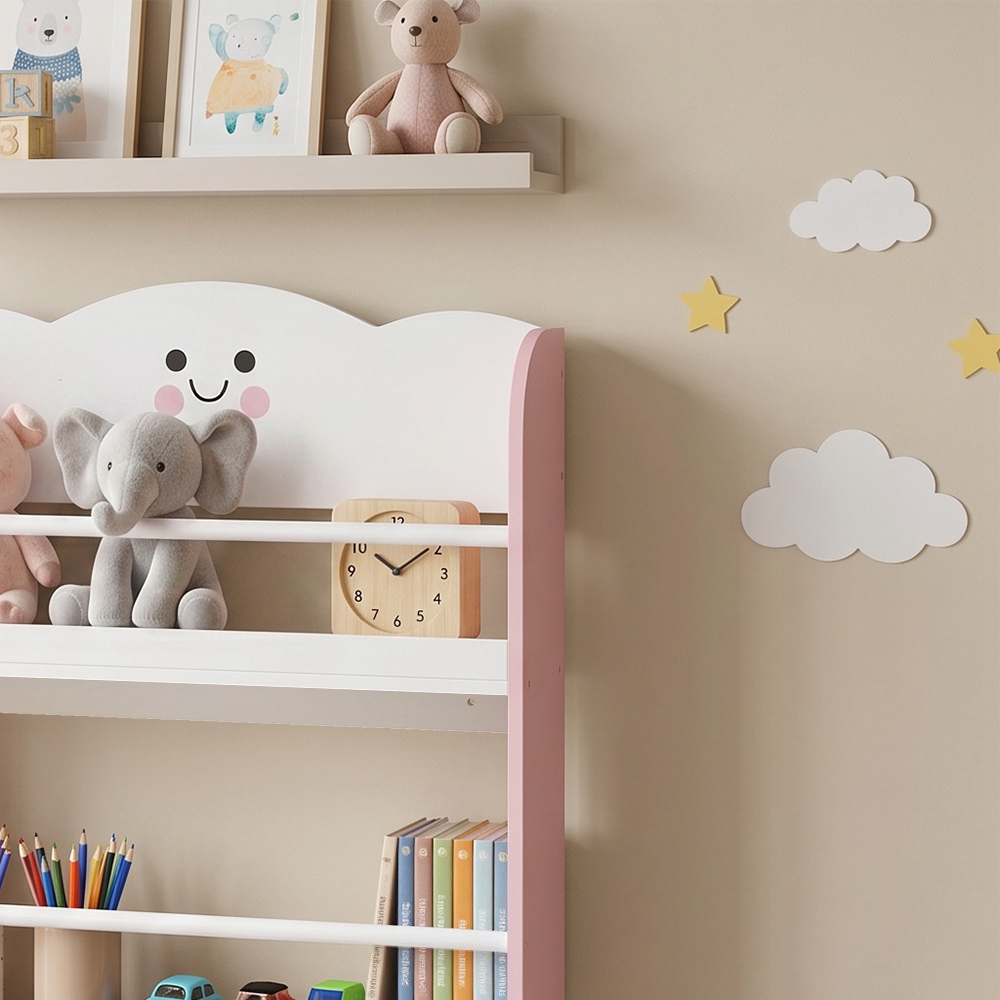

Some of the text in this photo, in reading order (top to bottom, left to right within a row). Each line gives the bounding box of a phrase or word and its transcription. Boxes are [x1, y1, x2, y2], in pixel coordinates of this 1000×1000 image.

[352, 543, 367, 554] 10
[347, 564, 356, 577] 9
[440, 567, 448, 580] 3
[354, 590, 363, 603] 8
[433, 593, 441, 605] 4
[371, 609, 379, 620] 7
[416, 610, 425, 622] 5
[393, 615, 402, 628] 6
